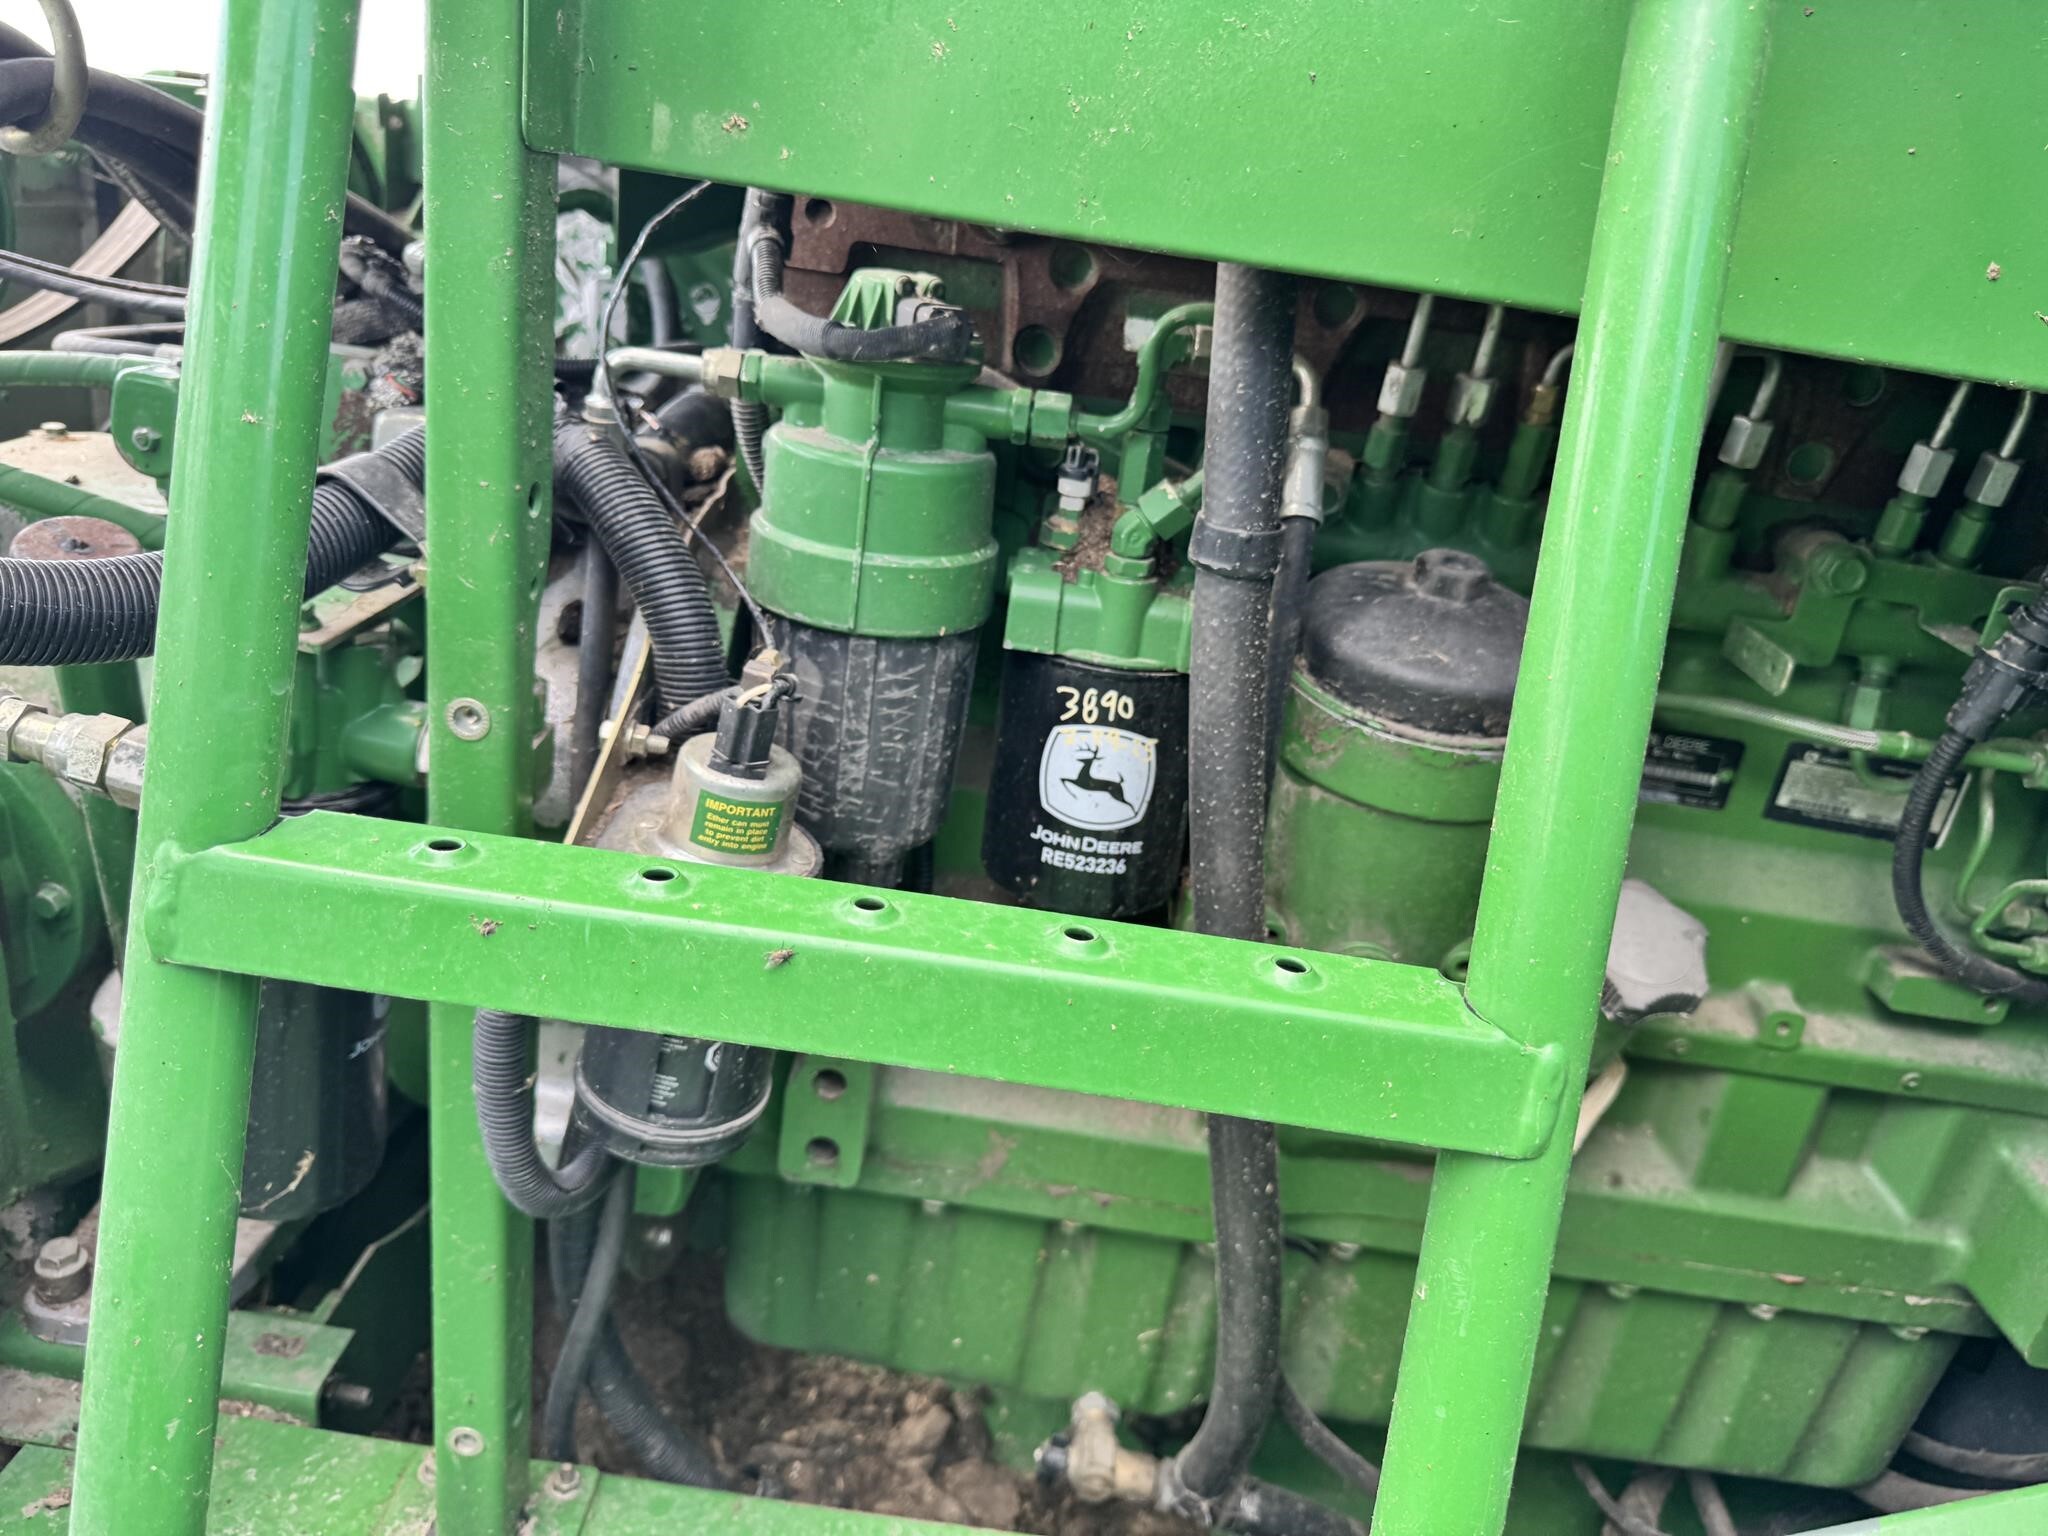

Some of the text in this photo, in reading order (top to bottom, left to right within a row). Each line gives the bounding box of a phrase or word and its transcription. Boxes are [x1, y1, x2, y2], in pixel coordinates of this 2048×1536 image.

[1056, 685, 1135, 724] 3890
[704, 798, 776, 818] IMPORTANT
[704, 821, 734, 833] remain
[735, 826, 745, 834] in
[731, 820, 748, 828] can
[697, 834, 720, 846] entry
[721, 841, 739, 849] into
[705, 828, 714, 836] to
[715, 832, 749, 843] prevent
[1030, 824, 1144, 855] JOHN DEERE
[1041, 846, 1127, 875] RE523236
